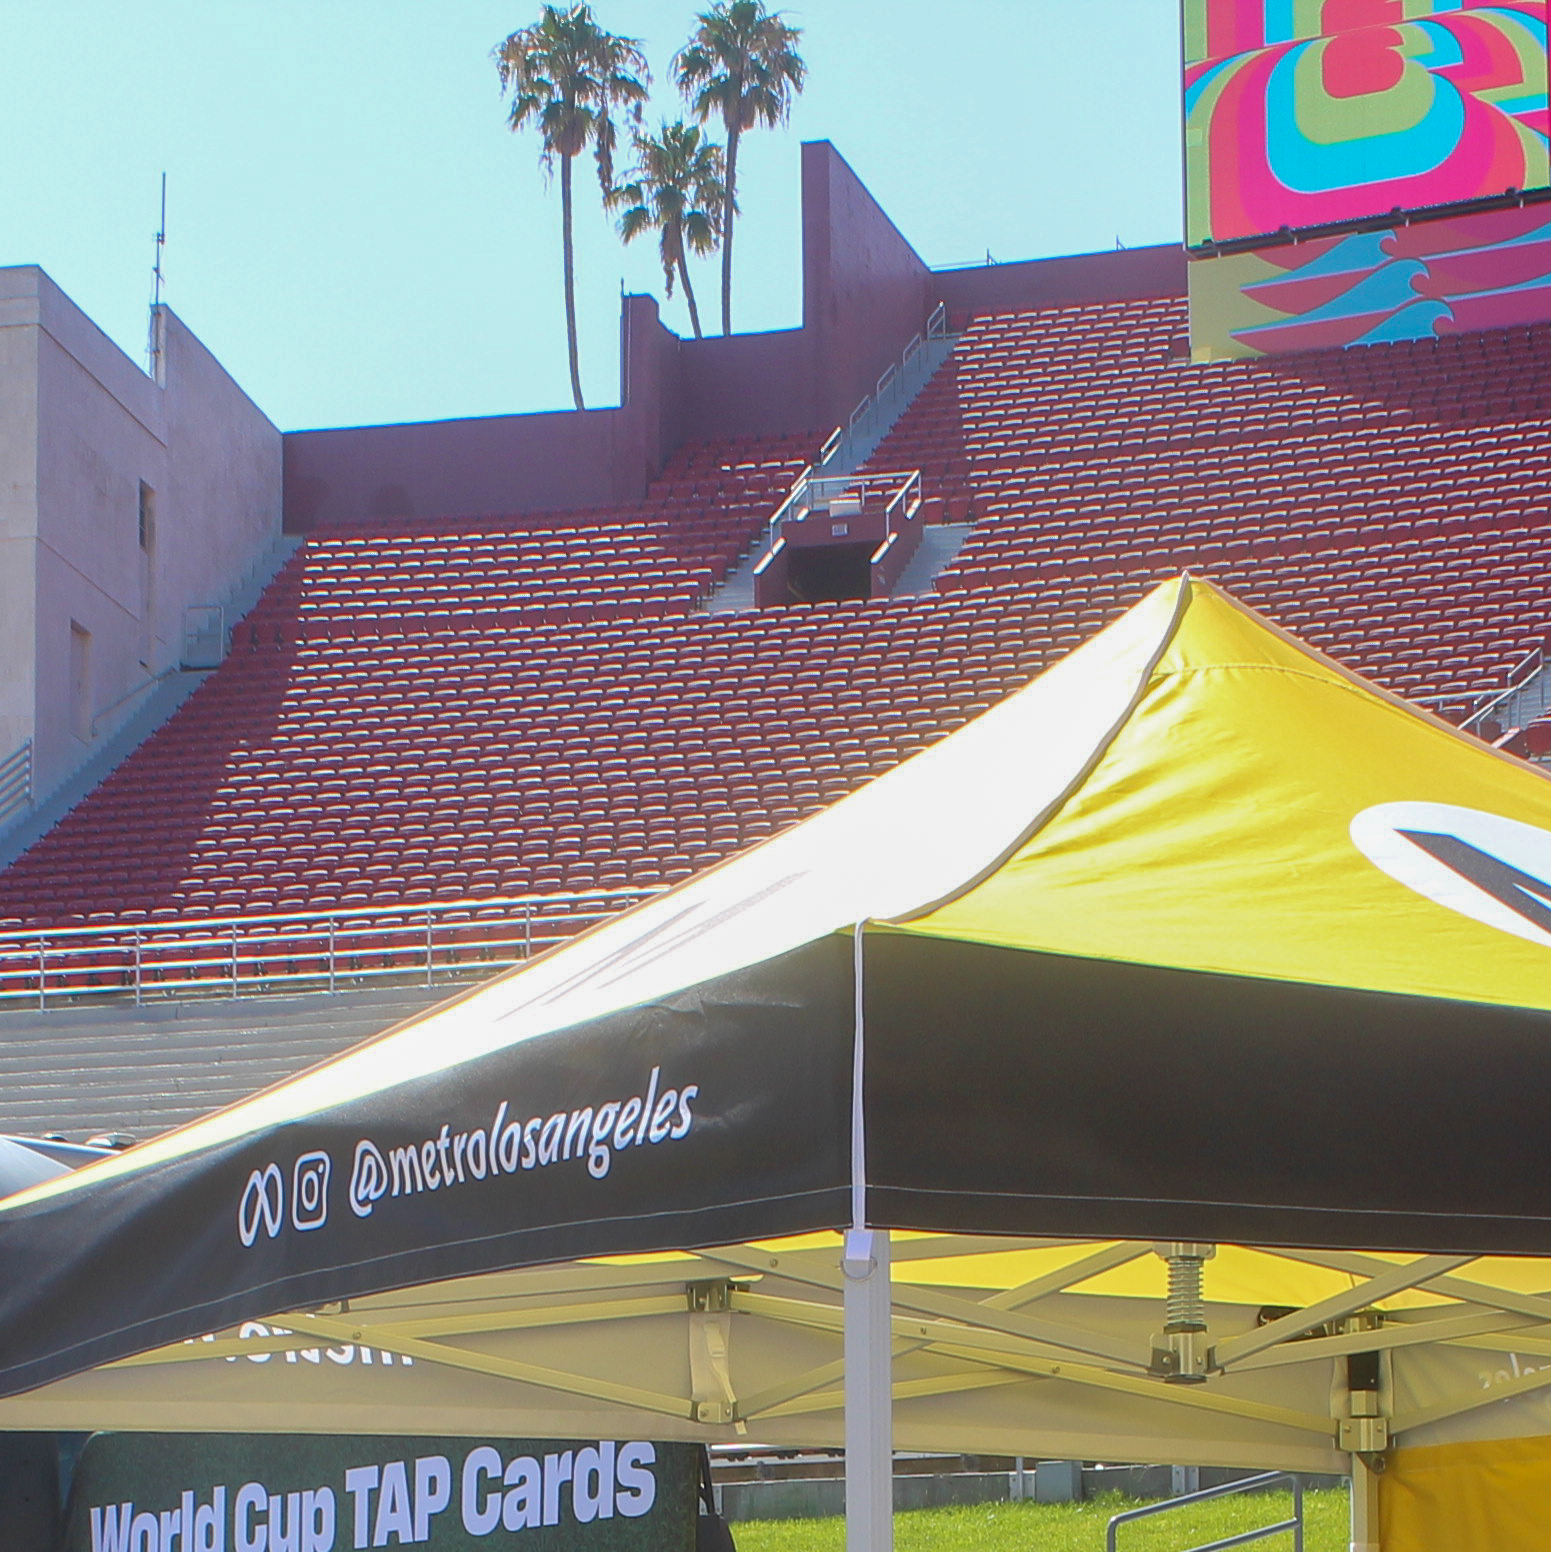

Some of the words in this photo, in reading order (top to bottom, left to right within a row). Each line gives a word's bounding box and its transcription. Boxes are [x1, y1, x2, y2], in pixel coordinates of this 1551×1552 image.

[349, 1066, 699, 1218] @metrolosangeles
[345, 1454, 451, 1549] TAP
[461, 1440, 656, 1535] Cards
